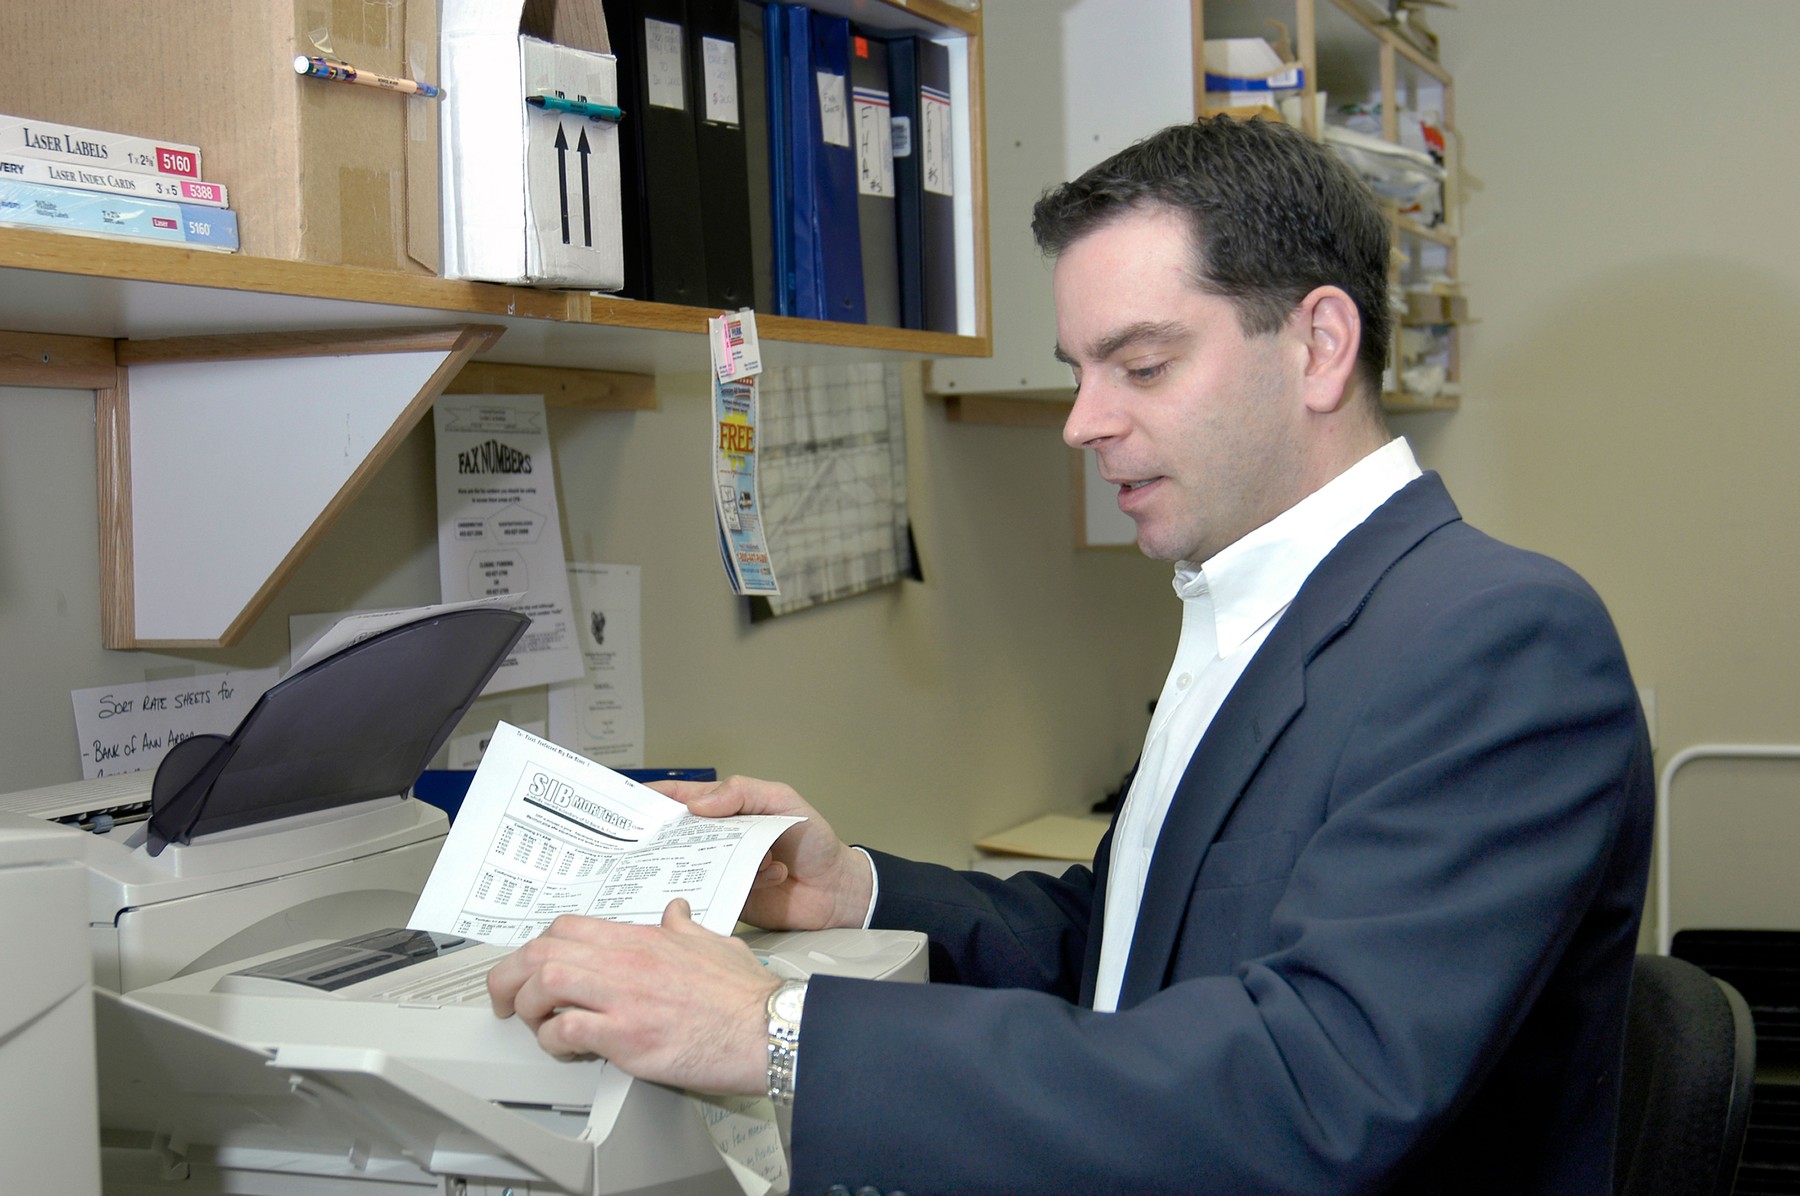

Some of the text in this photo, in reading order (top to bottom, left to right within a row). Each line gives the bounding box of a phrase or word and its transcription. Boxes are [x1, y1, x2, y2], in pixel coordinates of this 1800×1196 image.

[163, 153, 190, 173] 5160
[189, 184, 213, 200] 5388
[719, 422, 754, 453] FREE
[458, 438, 532, 474] FAX NUMBERS
[142, 696, 167, 712] RATE
[174, 690, 211, 709] SHEETS
[217, 681, 235, 700] for
[528, 772, 574, 809] SIB
[572, 794, 632, 831] MORTGAGE
